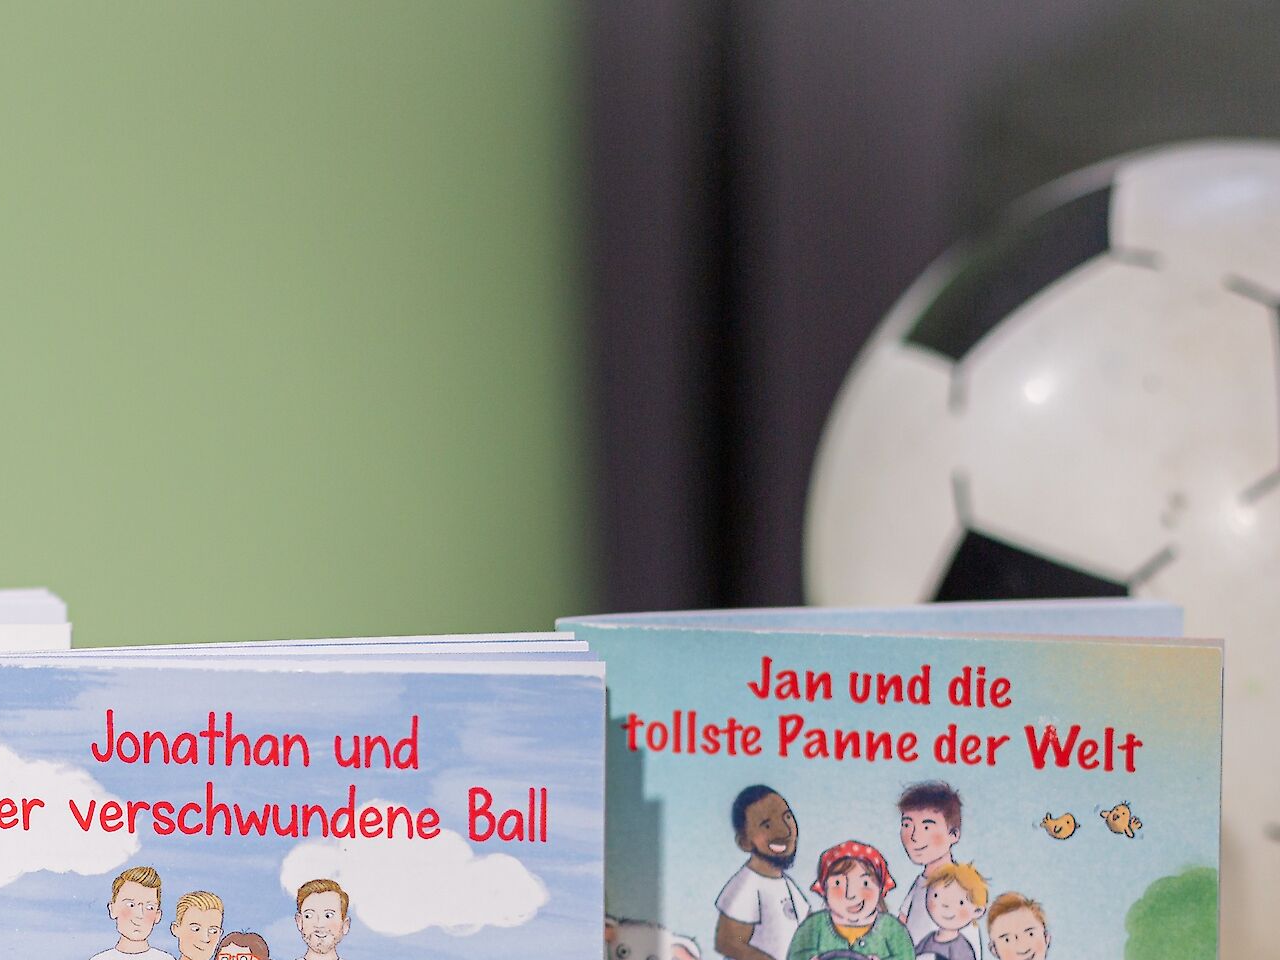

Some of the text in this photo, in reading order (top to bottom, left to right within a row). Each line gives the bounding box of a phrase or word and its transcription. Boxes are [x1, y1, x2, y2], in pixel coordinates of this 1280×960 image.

[747, 655, 1013, 709] Jan und die
[90, 708, 420, 770] Jonathan und
[623, 709, 1144, 773] tollste Panne der Welt
[68, 780, 443, 841] verschwundene
[467, 785, 549, 844] Ball
